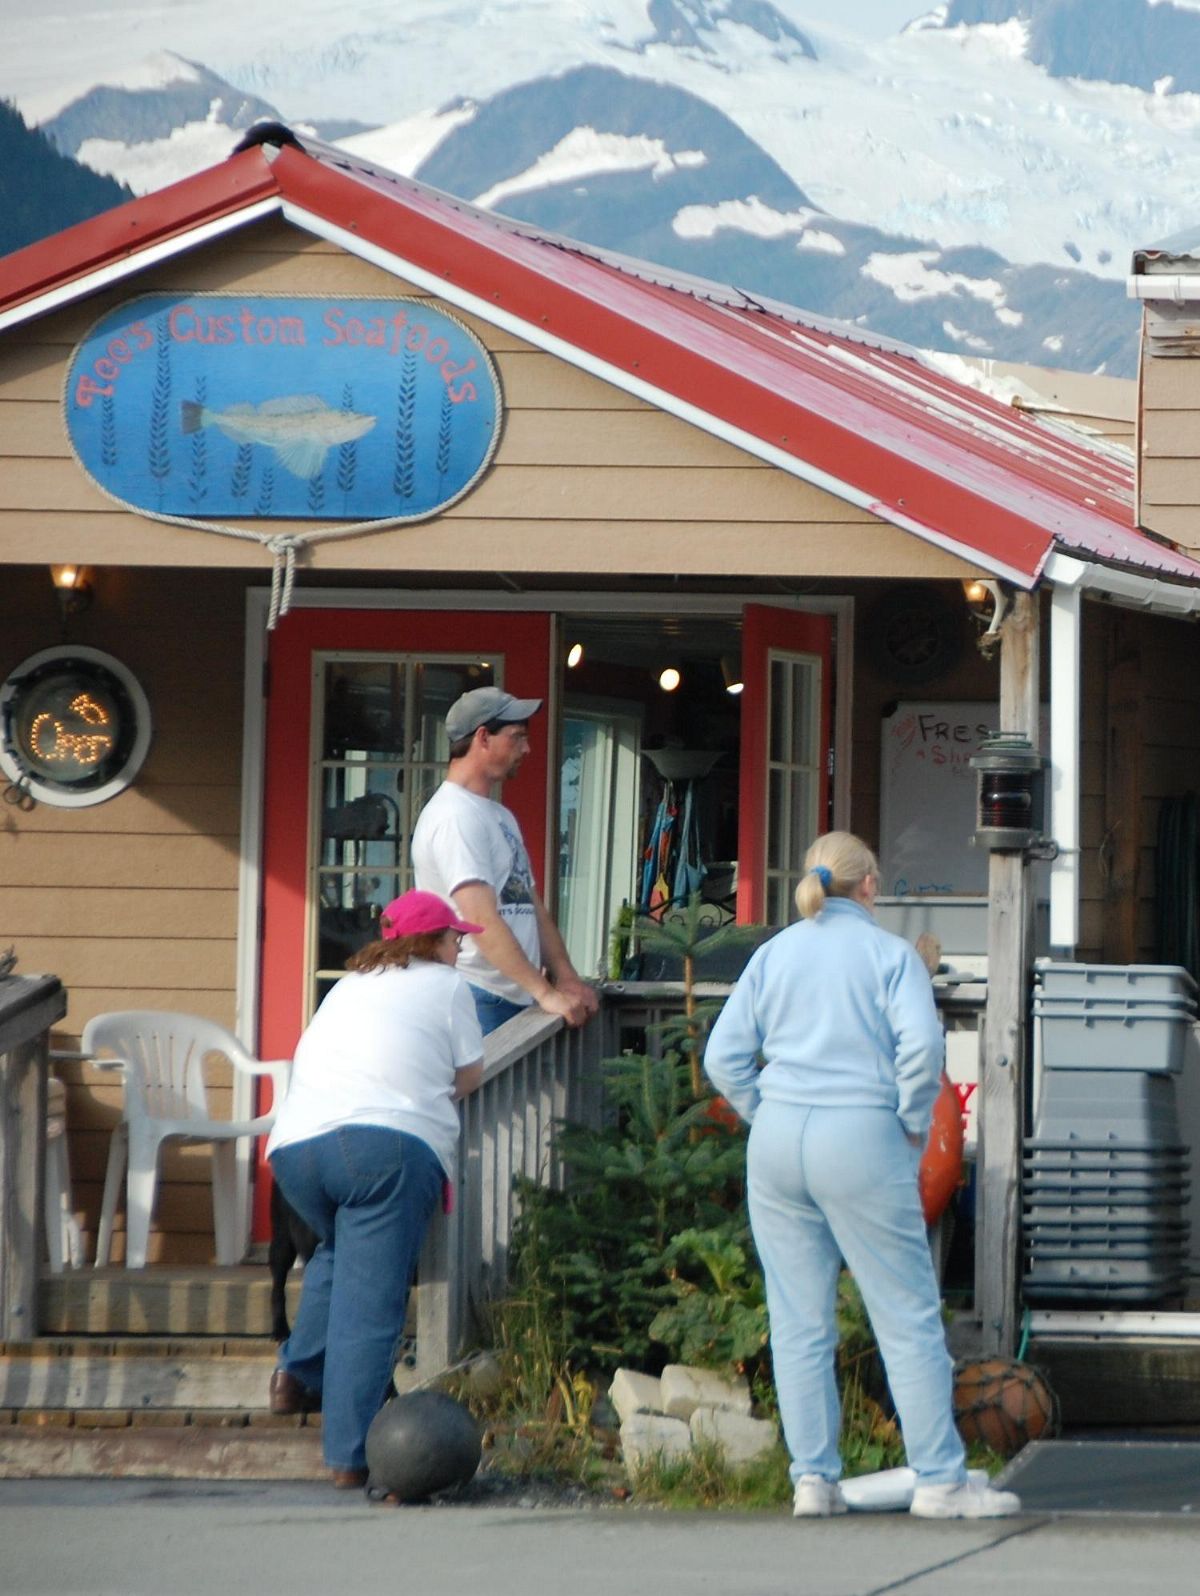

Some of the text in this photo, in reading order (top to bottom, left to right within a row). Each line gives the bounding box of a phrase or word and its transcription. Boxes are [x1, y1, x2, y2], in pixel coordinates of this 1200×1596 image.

[168, 304, 306, 345] Custom
[322, 306, 477, 404] Seafoods
[918, 713, 990, 743] FRES
